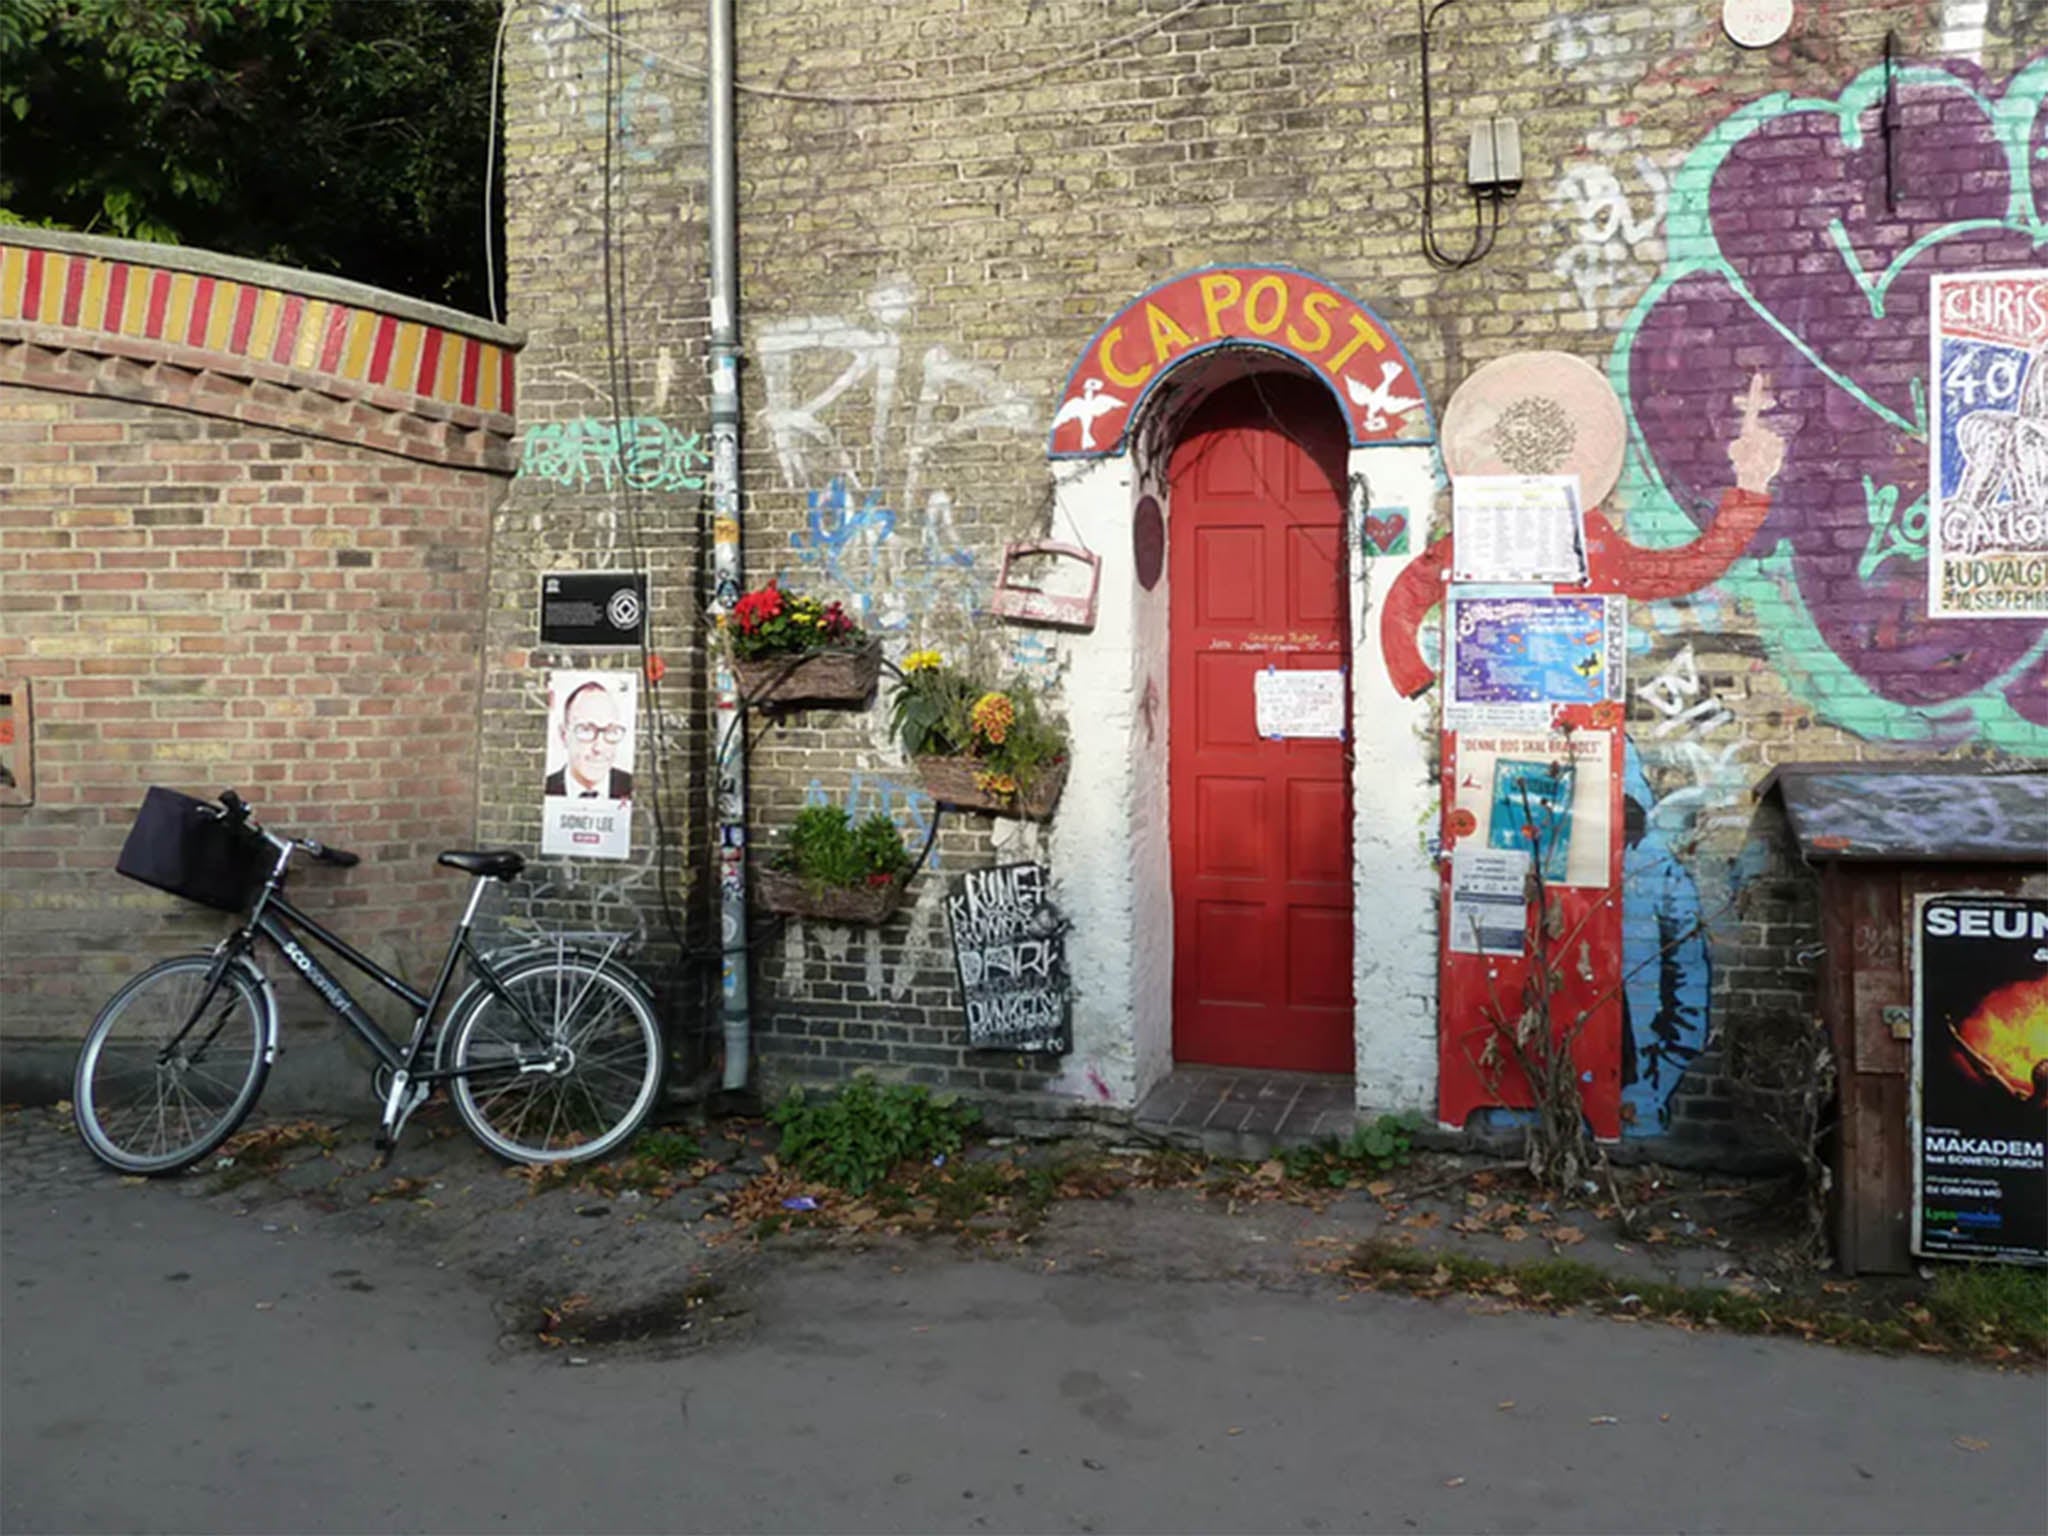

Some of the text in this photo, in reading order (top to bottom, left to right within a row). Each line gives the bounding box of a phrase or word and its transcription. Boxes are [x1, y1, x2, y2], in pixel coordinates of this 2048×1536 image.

[1199, 272, 1386, 375] POST
[1944, 350, 2020, 404] 40
[1955, 559, 2048, 588] UDVALG
[1926, 1136, 2045, 1157] MAKADEM
[1948, 1156, 2000, 1167] SOWETO
